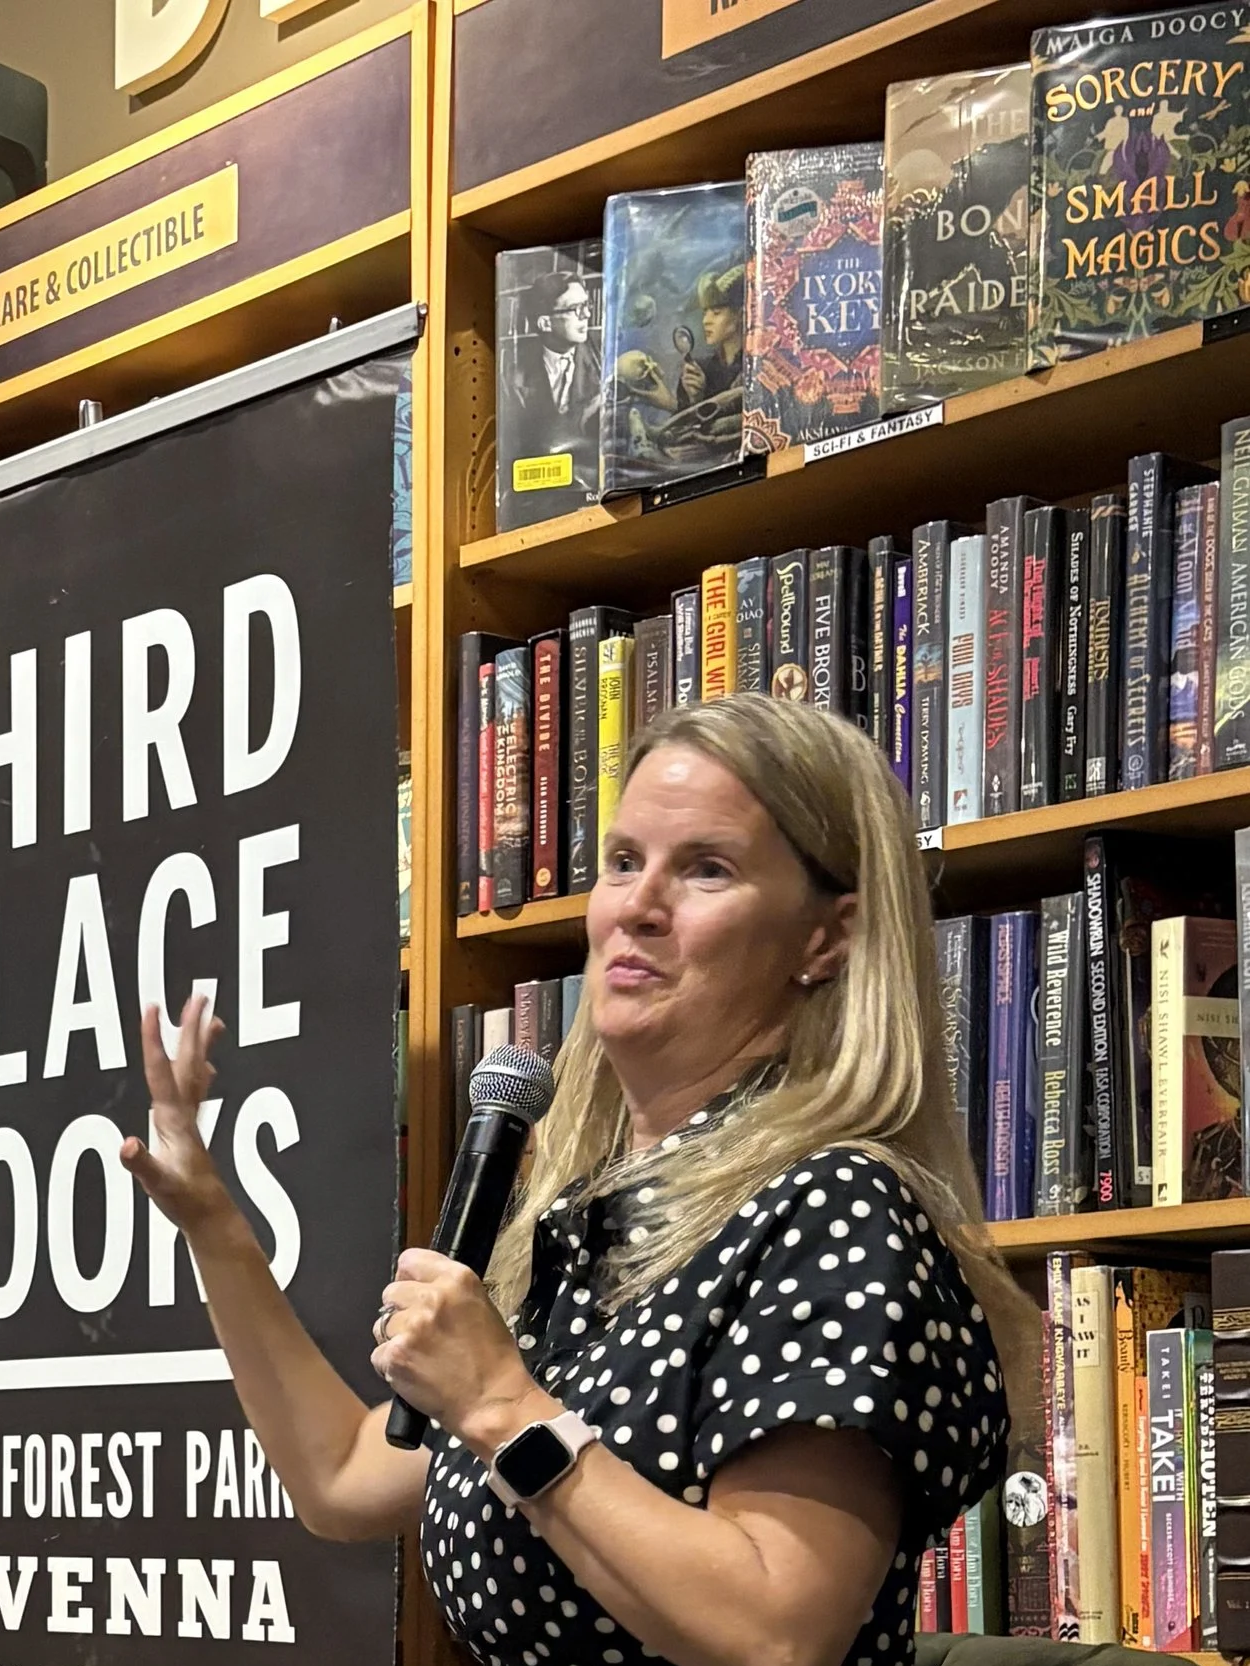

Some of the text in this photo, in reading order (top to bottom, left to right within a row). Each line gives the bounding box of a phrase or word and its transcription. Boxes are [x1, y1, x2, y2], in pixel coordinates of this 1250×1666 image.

[1046, 8, 1245, 55] MAIGA DOOCY
[1046, 59, 1244, 122] SORCERY
[1128, 102, 1155, 118] and
[1066, 170, 1218, 224] SMALL
[46, 270, 62, 302] &
[66, 203, 206, 295] COLLECTIBLE
[1062, 221, 1221, 281] MAGICS
[914, 355, 1006, 381] JACKSON
[813, 435, 852, 457] SCI-FI
[855, 431, 865, 444] &
[869, 409, 935, 438] FANTASY
[1231, 476, 1250, 553] GAIMAN
[916, 539, 931, 636] AMBERJACK
[990, 533, 1000, 590] FOODY
[999, 525, 1010, 594] AMANDA
[705, 571, 726, 661] THE GIRL
[775, 561, 804, 654] Spellbound
[814, 594, 831, 639] FIVE
[1230, 562, 1249, 660] AMERICAN
[1065, 531, 1084, 756] SHADES NOTHINGNESS Gary Fry
[1126, 573, 1151, 748] ALCHEMY SECRETS
[895, 645, 907, 700] DAHLIA
[1228, 665, 1247, 720] GODS
[538, 653, 551, 752] THE DIVIDE
[495, 735, 505, 815] KINGDOM
[505, 735, 517, 814] ELECTRIC
[1087, 873, 1104, 957] SHADOWRUN
[1090, 960, 1106, 1012] SECOND
[1042, 928, 1070, 1175] Wild Reverence Rebecca Ross
[1092, 1014, 1108, 1061] EDITION
[1157, 969, 1169, 1159] NISI SHAWL EVERFAIR
[1099, 1170, 1112, 1202] 7900
[1051, 1257, 1062, 1291] EMILY
[1052, 1291, 1064, 1325] KAME
[1118, 1329, 1134, 1374] Beauty
[1160, 1347, 1171, 1399] TAKEI
[1, 1431, 162, 1519] FOREST
[1150, 1409, 1175, 1502] TAKEI
[936, 1547, 949, 1579] Flora
[951, 1549, 965, 1581] Flora
[967, 1571, 981, 1607] Flora
[922, 1580, 935, 1612] Flora
